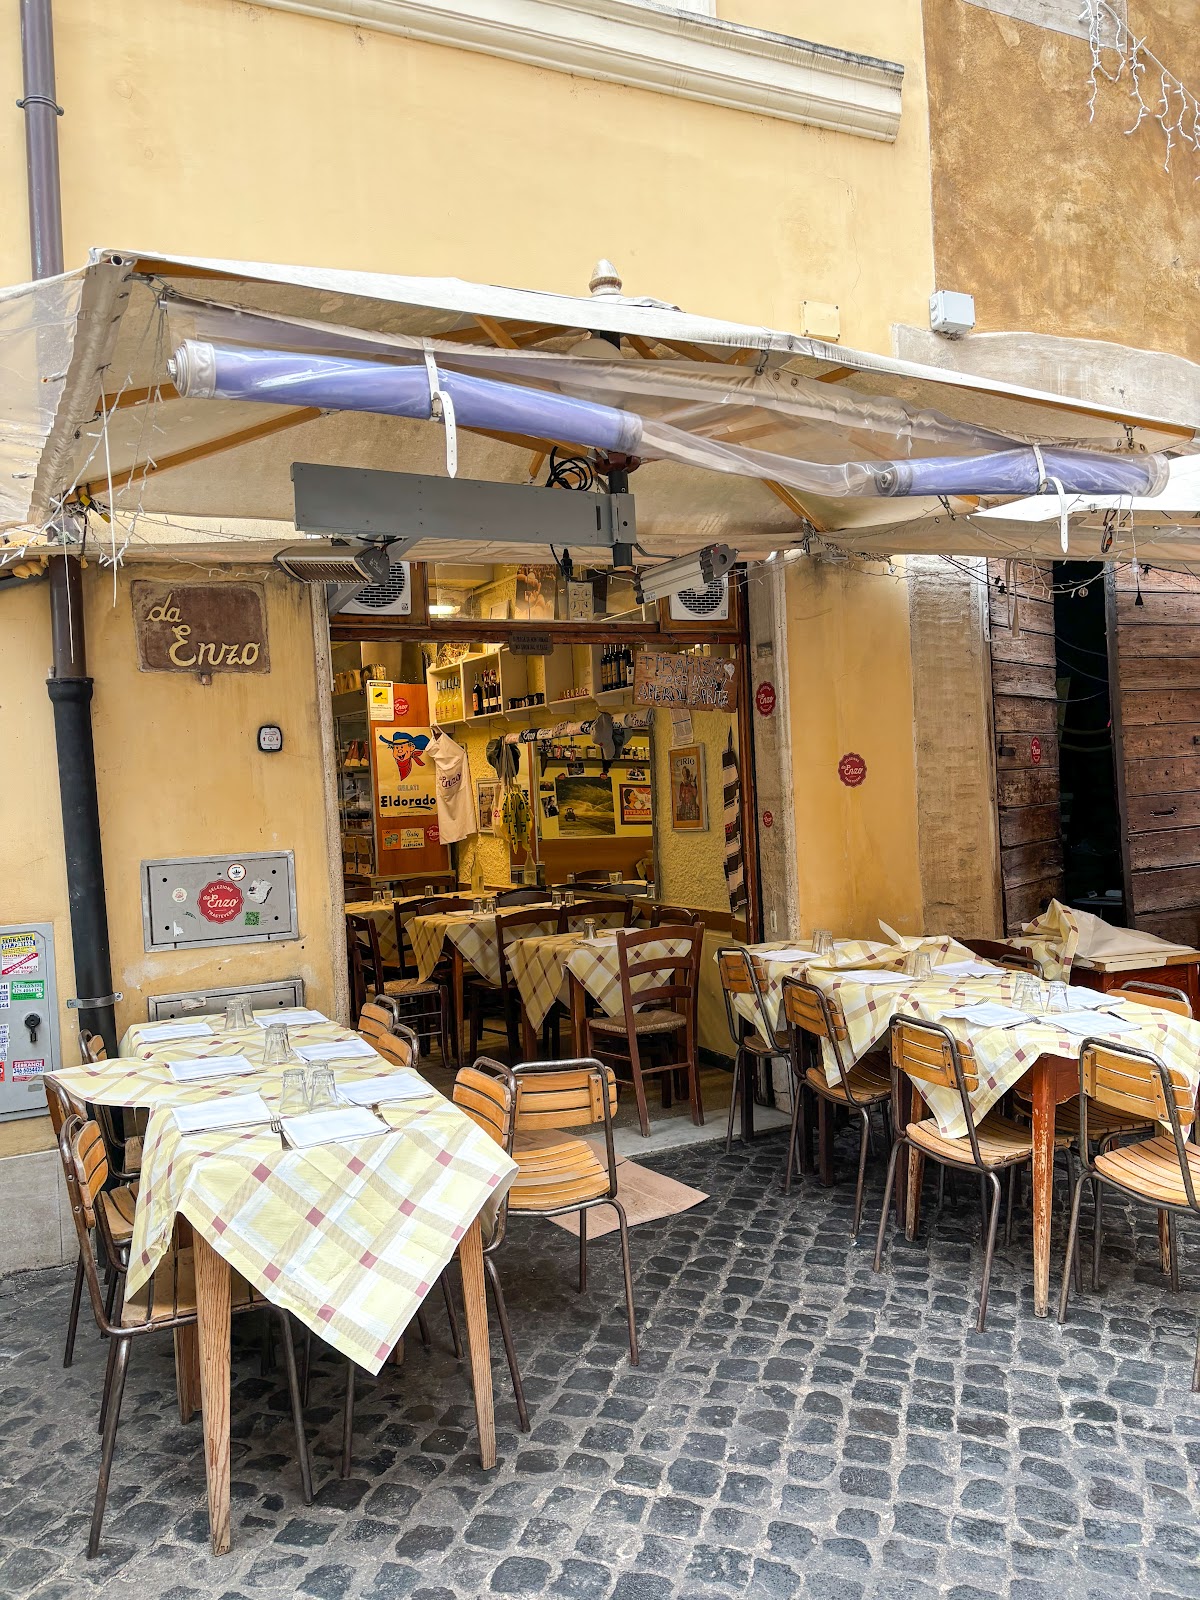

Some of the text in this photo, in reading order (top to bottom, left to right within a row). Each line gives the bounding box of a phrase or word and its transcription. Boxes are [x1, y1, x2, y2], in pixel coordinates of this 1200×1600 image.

[146, 592, 183, 622] da
[168, 624, 261, 667] Enzo
[760, 693, 774, 704] Enzo
[675, 757, 695, 768] CIRIO
[844, 764, 863, 775] Enzo
[441, 773, 461, 788] Enzo
[380, 794, 436, 808] Eldorado
[208, 884, 234, 894] SELEZIONE
[207, 894, 238, 908] Enzo
[207, 909, 235, 919] TRASTEVERE
